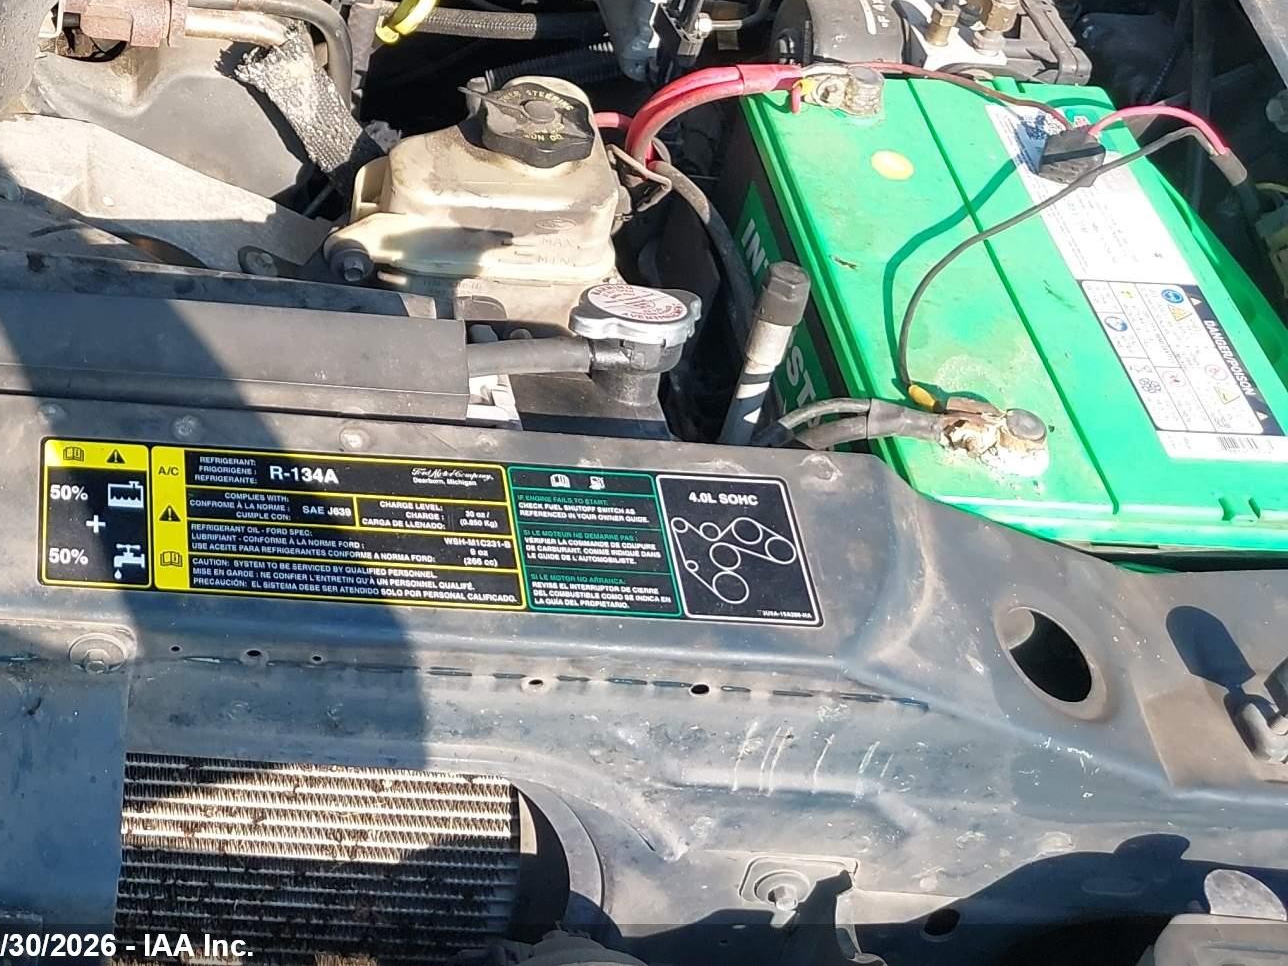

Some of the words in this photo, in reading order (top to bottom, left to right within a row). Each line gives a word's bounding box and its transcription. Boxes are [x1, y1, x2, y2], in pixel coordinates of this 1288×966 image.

[537, 255, 570, 265] MIN
[1203, 320, 1256, 395] DANGER/POISON
[199, 456, 256, 466] REFRIGERANT:
[157, 465, 179, 475] A/C
[268, 465, 339, 483] R-134A
[194, 473, 257, 484] REFRIGERANTE:
[412, 476, 445, 484] Dearborn,
[446, 478, 477, 486] Michigan
[50, 485, 88, 500] 50%
[224, 491, 264, 501] COMPLIES
[265, 494, 289, 502] WITH:
[687, 491, 717, 503] 4.0L
[717, 493, 759, 506] SOHC
[236, 500, 242, 509] À
[256, 503, 285, 511] NORME
[302, 505, 324, 514] SAE
[327, 506, 351, 516] J639
[379, 500, 413, 509] CHARGE
[414, 503, 443, 511] LEVEL:
[235, 511, 268, 519] CUMPLE
[405, 511, 439, 520] CHARGE
[361, 518, 390, 526] CARGA
[404, 520, 445, 529] LLENADO:
[191, 523, 245, 532] REFRIGERANT
[265, 527, 287, 535] FORD
[289, 528, 312, 536] SPEC:
[191, 532, 236, 541] LUBRIFIANT
[242, 535, 286, 544] CONFORME
[288, 536, 294, 544] À
[308, 539, 336, 547] NORME
[49, 548, 89, 565] 50%
[208, 543, 236, 551] ACEITE
[238, 544, 259, 552] PARA
[261, 546, 326, 556] REFRIGERANTES
[327, 550, 372, 559] CONFORME
[380, 553, 409, 561] NORMA
[410, 554, 435, 562] FORD:
[192, 557, 230, 566] CAUTION:
[233, 560, 265, 568] SYSTEM
[292, 563, 330, 571] SERVICED
[344, 566, 386, 575] QUALIFIED
[388, 569, 437, 578] PERSONNEL.
[192, 567, 211, 575] MISE
[225, 569, 253, 577] GARDE
[272, 572, 307, 580] CONFIER
[389, 579, 437, 588] PERSONNEL
[192, 575, 247, 587] PRECAUCIÓN:
[262, 581, 297, 590] SISTEMA
[298, 583, 320, 591] DEBE
[339, 586, 379, 594] ATENDIDO
[380, 588, 402, 596] SOLO
[404, 589, 421, 597] POR
[422, 591, 465, 599] PERSONAL
[466, 593, 517, 603] CALIFICADO.
